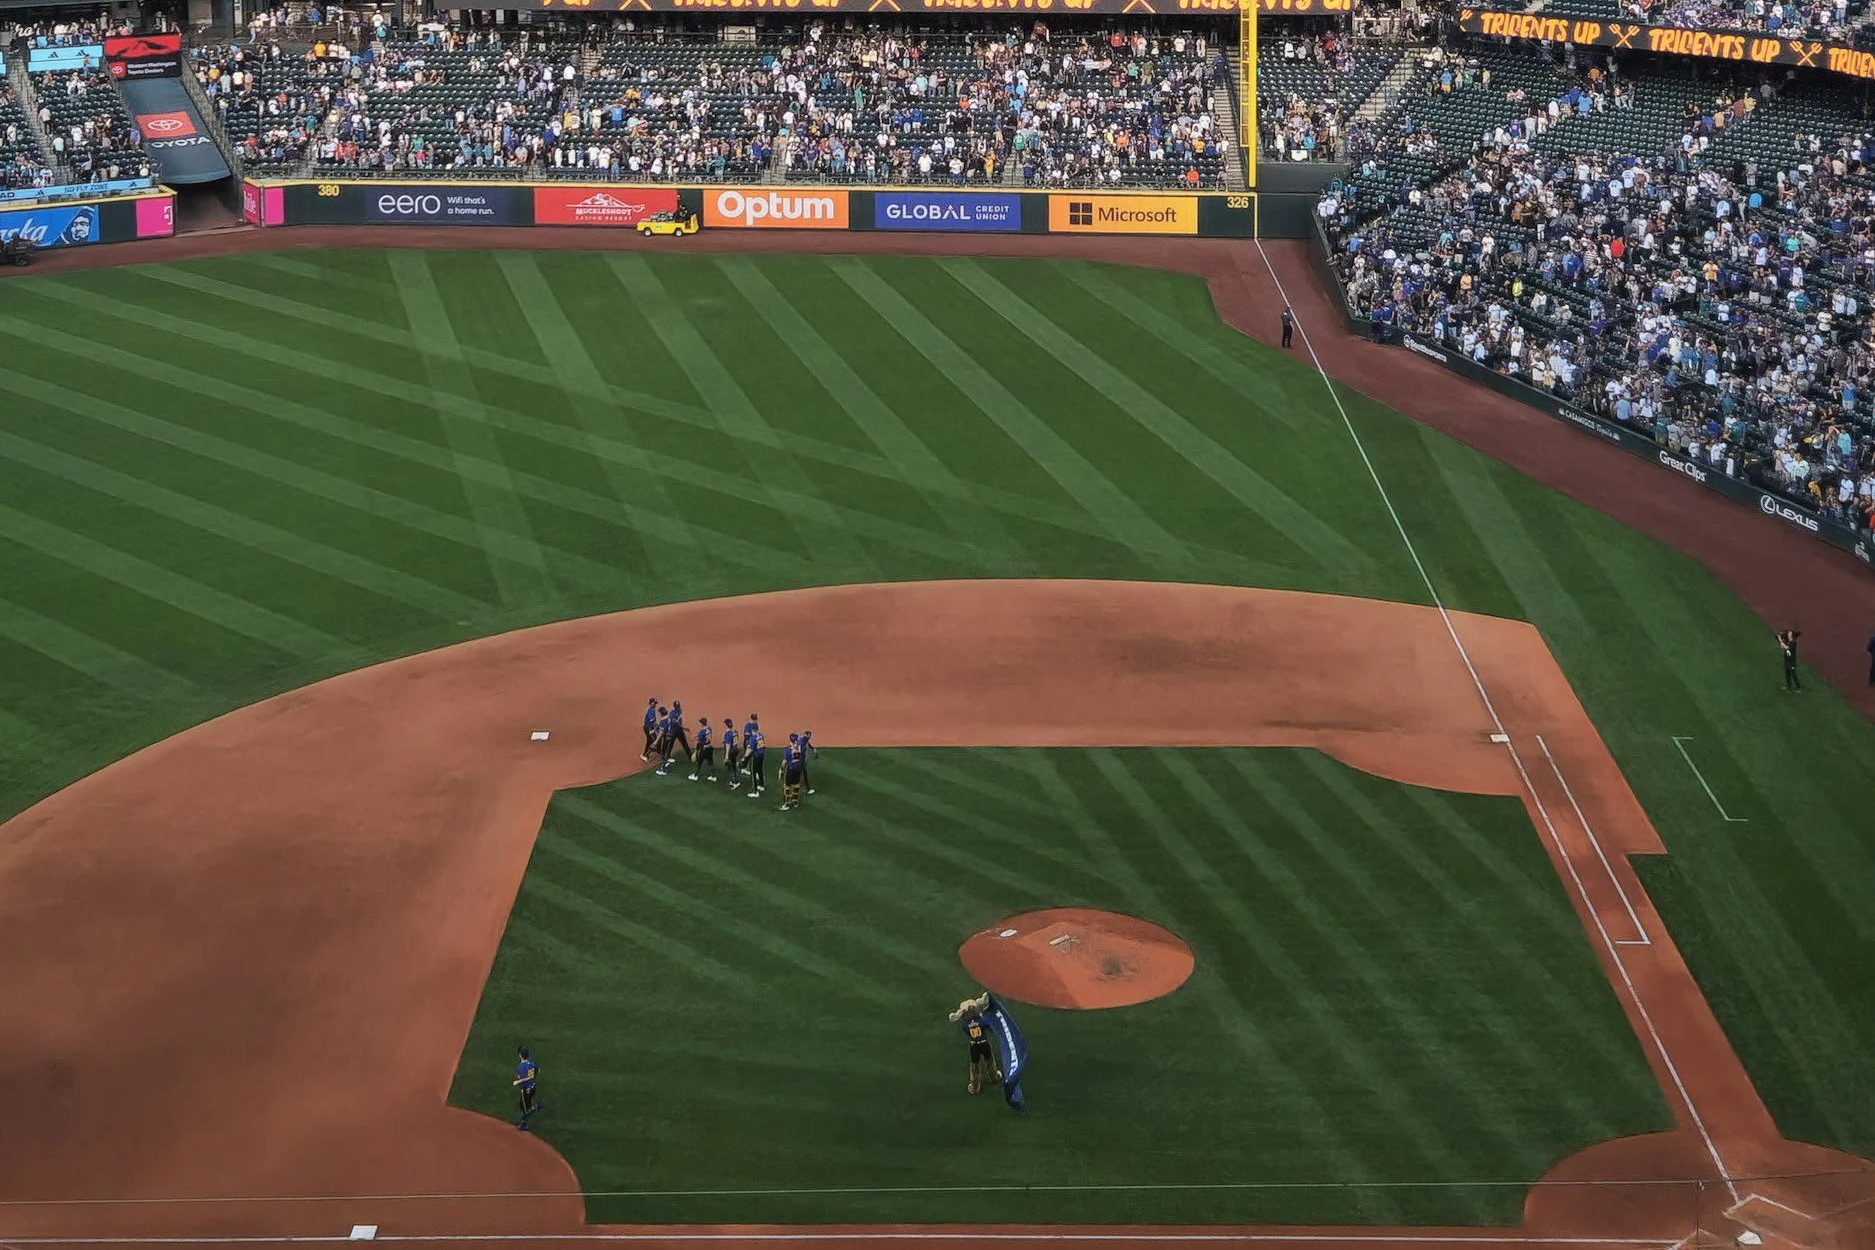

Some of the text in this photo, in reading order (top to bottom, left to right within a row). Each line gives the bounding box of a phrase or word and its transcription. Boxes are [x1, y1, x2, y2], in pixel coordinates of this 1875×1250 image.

[1480, 12, 1568, 42] TRIDENTS
[1573, 22, 1600, 45] UP
[1649, 29, 1745, 60] TRIDENTS
[1750, 38, 1781, 63] UP
[148, 136, 211, 148] OYOTA
[318, 185, 340, 196] 380
[378, 195, 441, 214] eero
[447, 196, 486, 204] Wifi that's
[1227, 197, 1249, 208] 326
[575, 208, 632, 216] MUCKLESHOOT
[717, 190, 834, 226] Optum
[886, 204, 971, 219] GLOBAL
[1098, 207, 1176, 222] Microsoft
[1659, 450, 1706, 482] Great Clips
[1776, 504, 1818, 532] LEXUS
